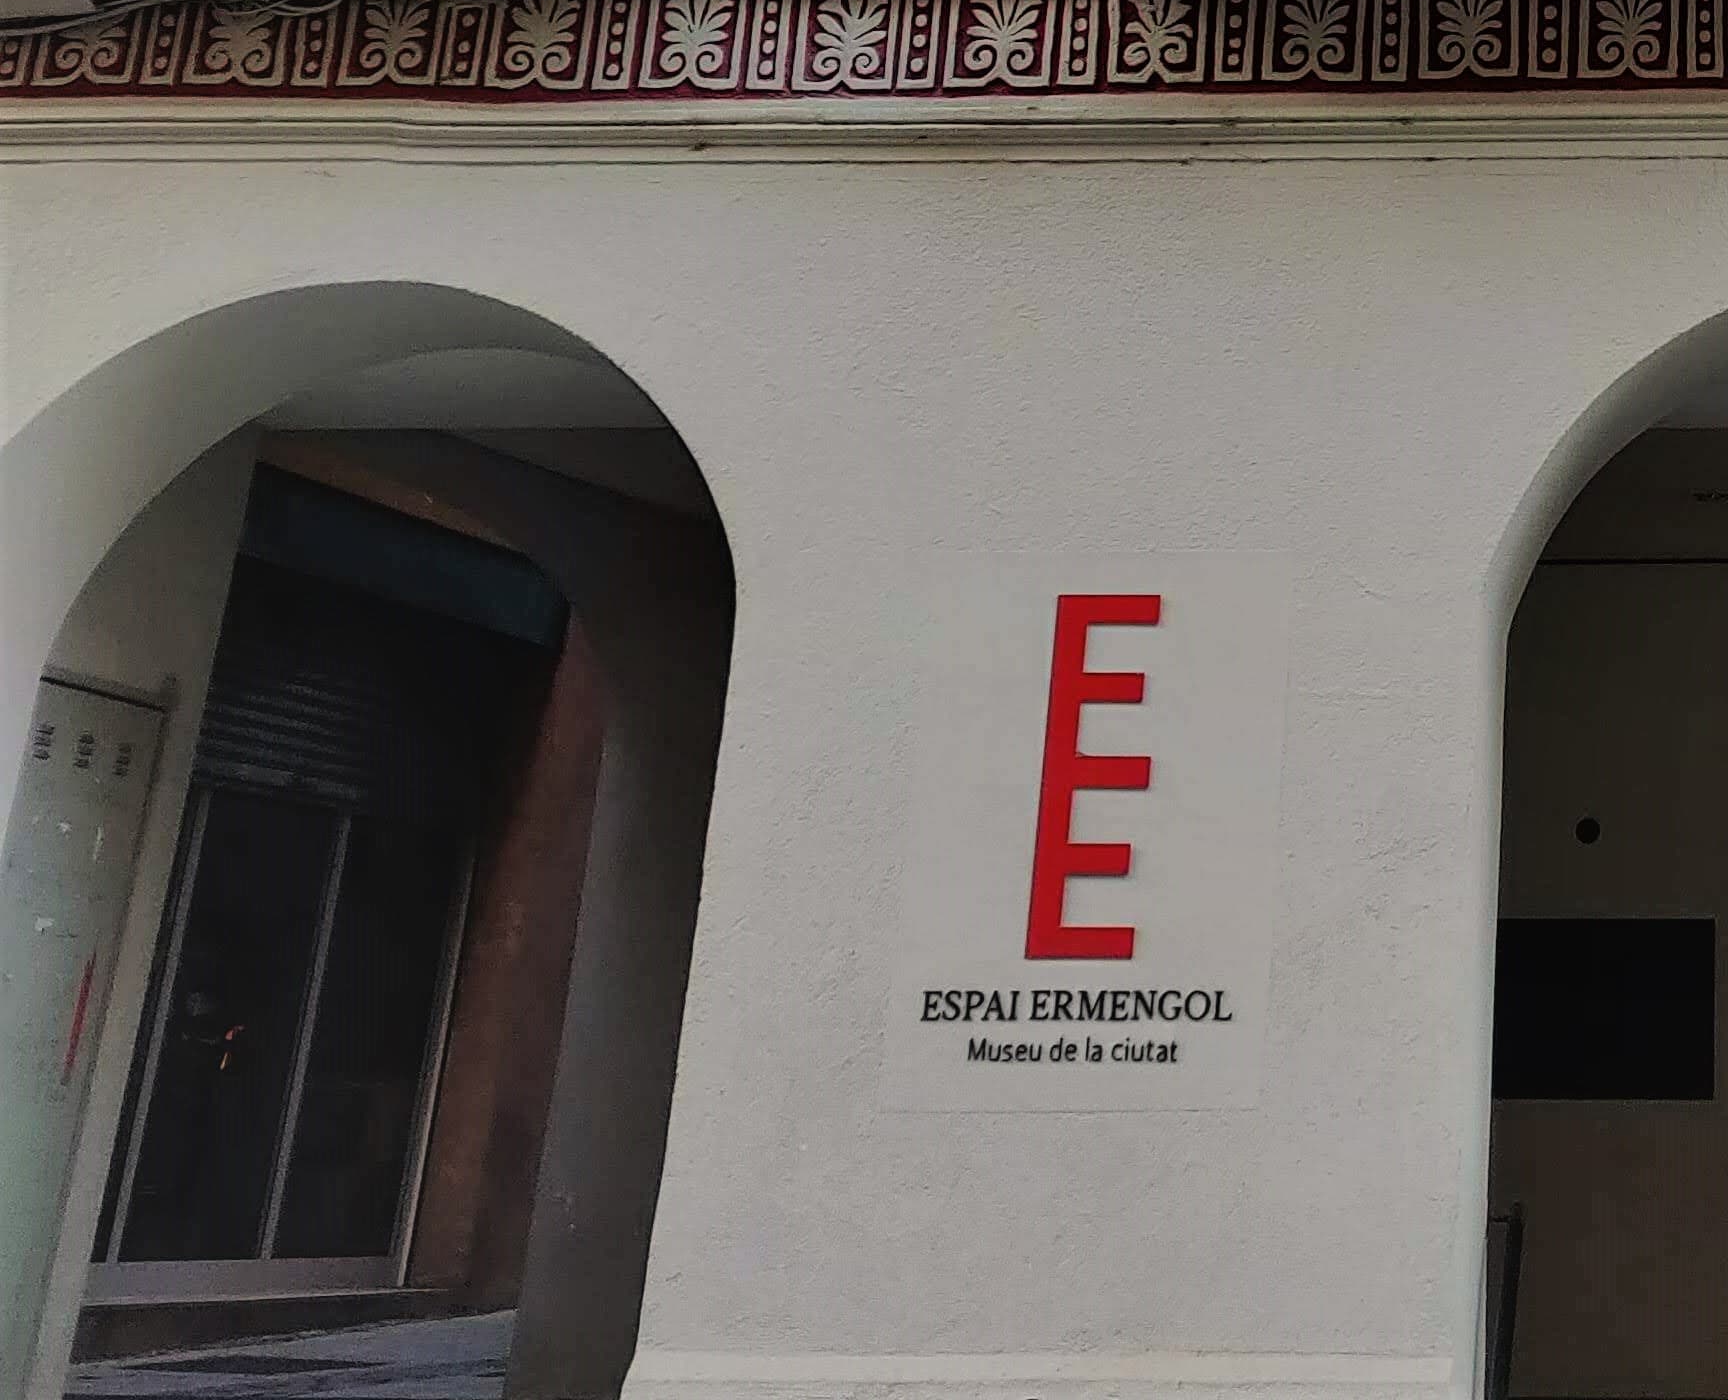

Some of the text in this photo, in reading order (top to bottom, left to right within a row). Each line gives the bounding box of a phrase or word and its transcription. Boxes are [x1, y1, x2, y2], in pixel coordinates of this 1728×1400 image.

[921, 990, 1233, 1023] ESPAI ERMENGOL
[967, 1037, 1178, 1064] Museu de la ciutat
